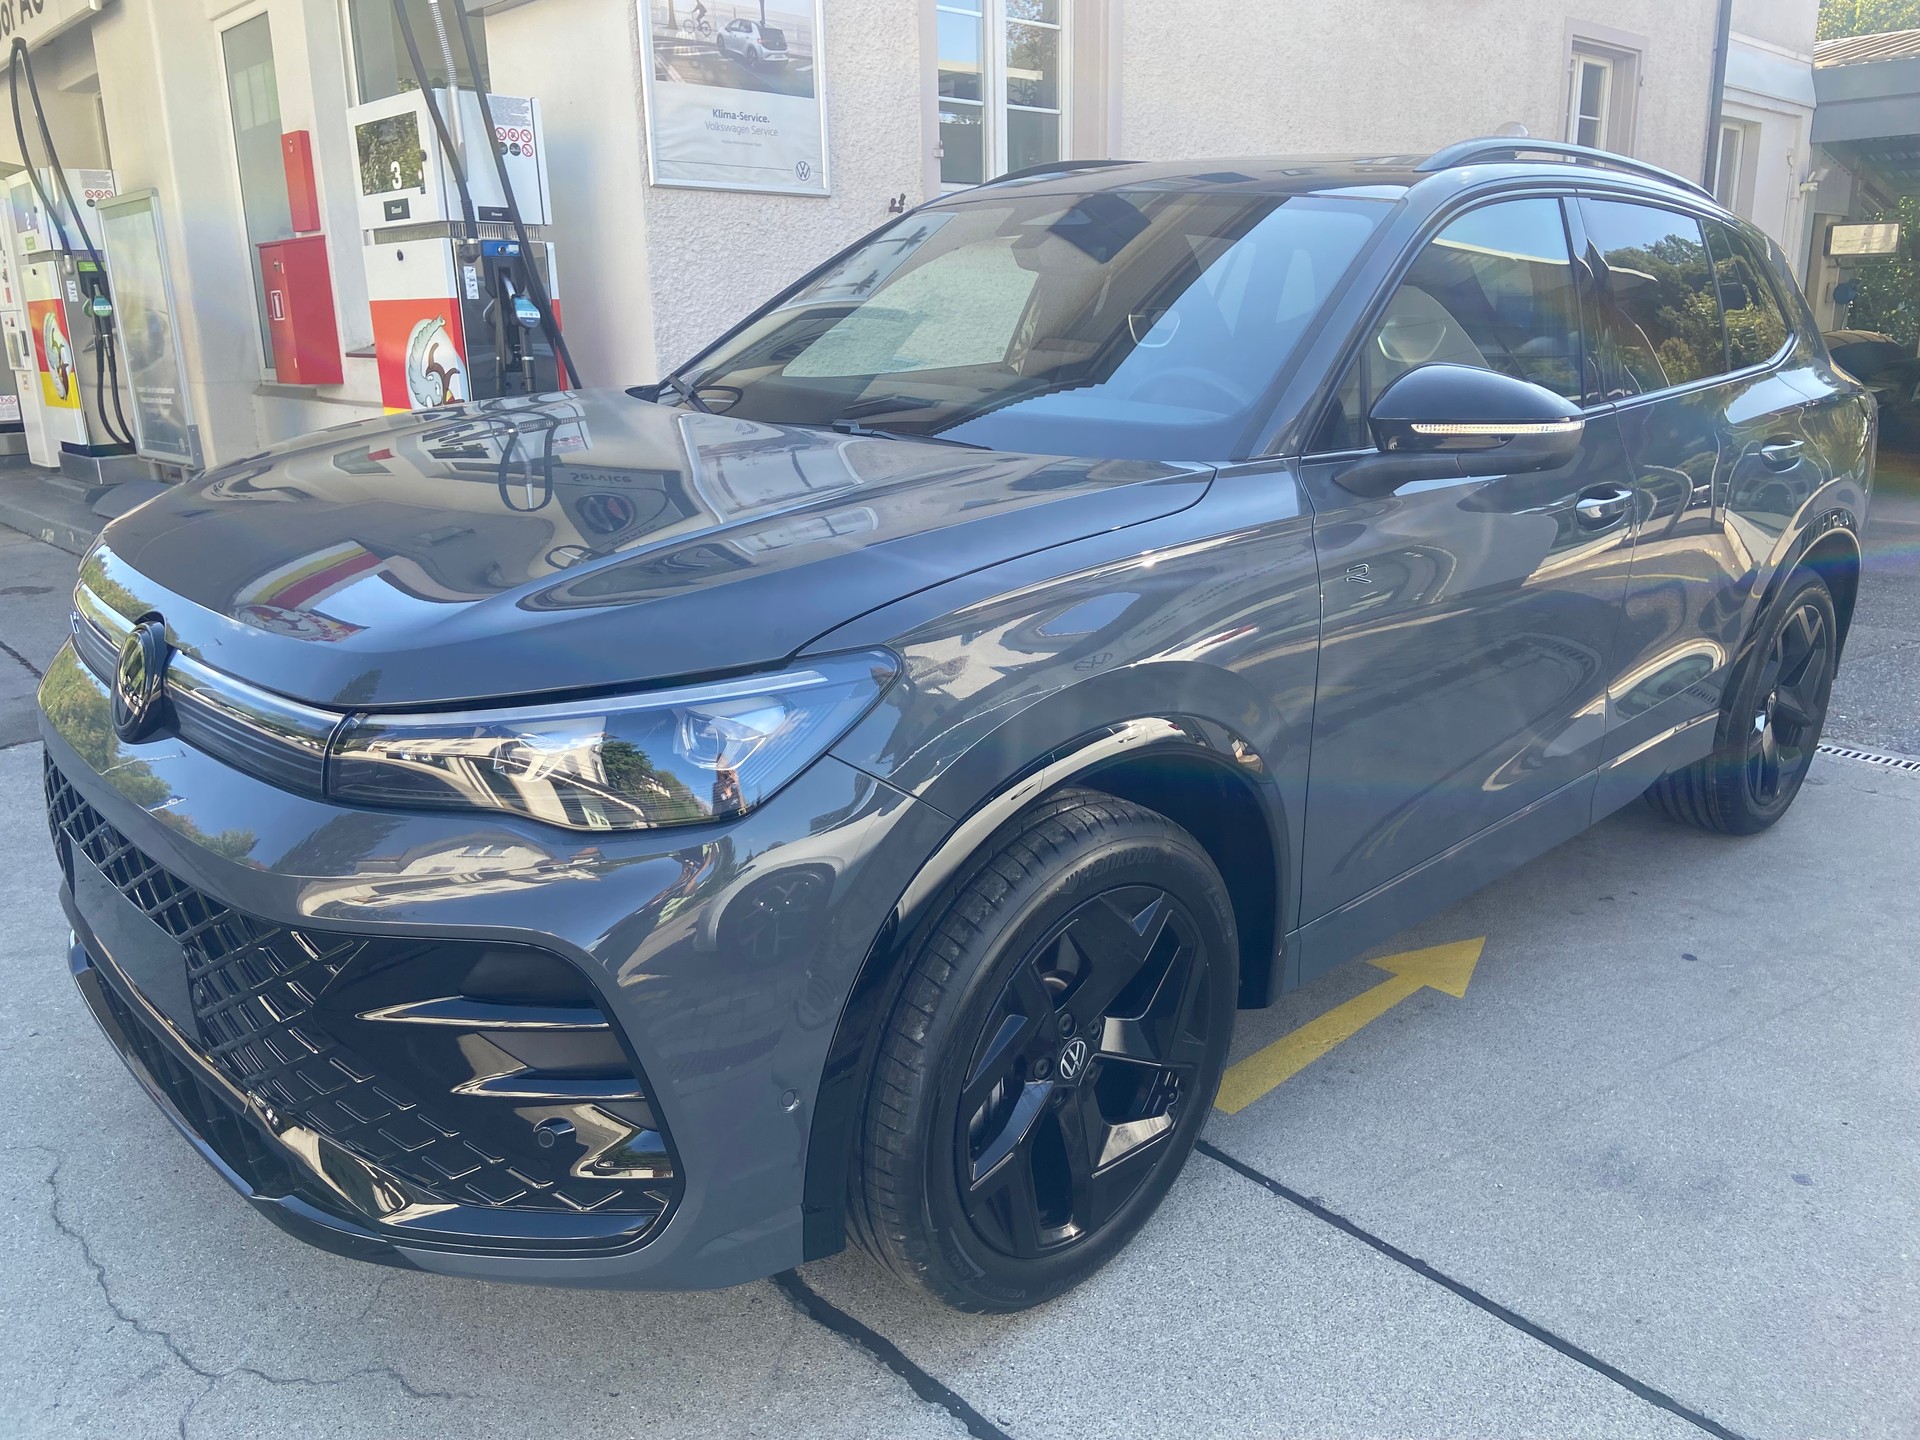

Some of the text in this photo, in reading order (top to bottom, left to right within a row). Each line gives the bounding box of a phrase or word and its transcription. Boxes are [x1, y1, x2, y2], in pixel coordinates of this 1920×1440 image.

[712, 108, 770, 123] Klima-Service.
[705, 121, 779, 137] Volkswagen Service
[390, 160, 403, 190] 3
[1346, 563, 1372, 584] R
